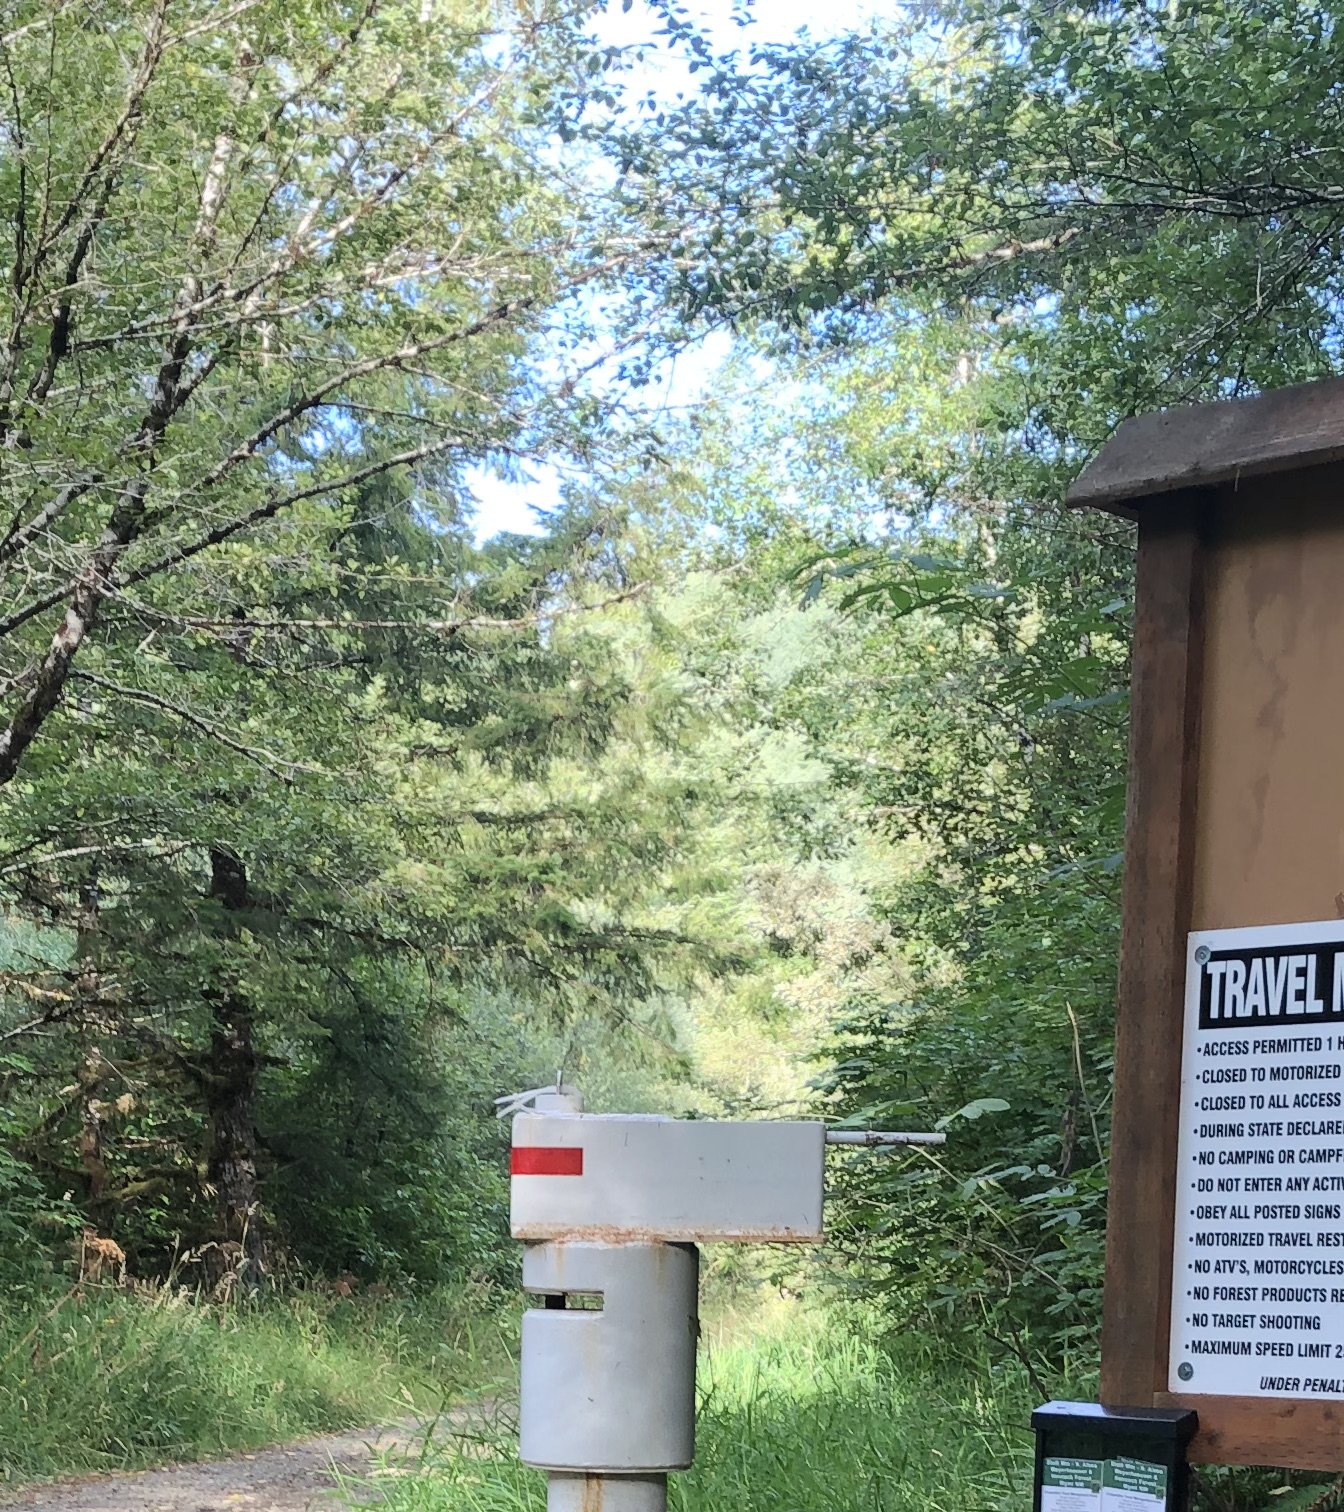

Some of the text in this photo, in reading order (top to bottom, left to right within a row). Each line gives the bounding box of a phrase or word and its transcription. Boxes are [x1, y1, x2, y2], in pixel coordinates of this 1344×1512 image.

[1207, 954, 1324, 1019] TRAVEL
[1203, 1040, 1250, 1057] ACCESS
[1253, 1037, 1322, 1055] PERMITTED
[1327, 1036, 1332, 1051] 1
[1202, 1068, 1247, 1084] CLOSED
[1251, 1067, 1266, 1082] TO
[1269, 1064, 1341, 1081] MOTORIZED
[1200, 1123, 1244, 1138] DURING
[1248, 1122, 1283, 1137] STATE
[1196, 1205, 1227, 1220] OBEY
[1229, 1205, 1250, 1219] ALL
[1254, 1205, 1301, 1219] POSTED
[1304, 1204, 1341, 1219] SIGNS
[1196, 1232, 1264, 1247] MOTORIZED
[1268, 1233, 1313, 1247] TRAVEL
[1192, 1313, 1321, 1330] NO TARGET SHOOTING
[1191, 1341, 1252, 1356] MAXIMUM
[1255, 1342, 1294, 1357] SPEED
[1298, 1343, 1332, 1358] LIMIT
[1260, 1376, 1301, 1392] UNDER
